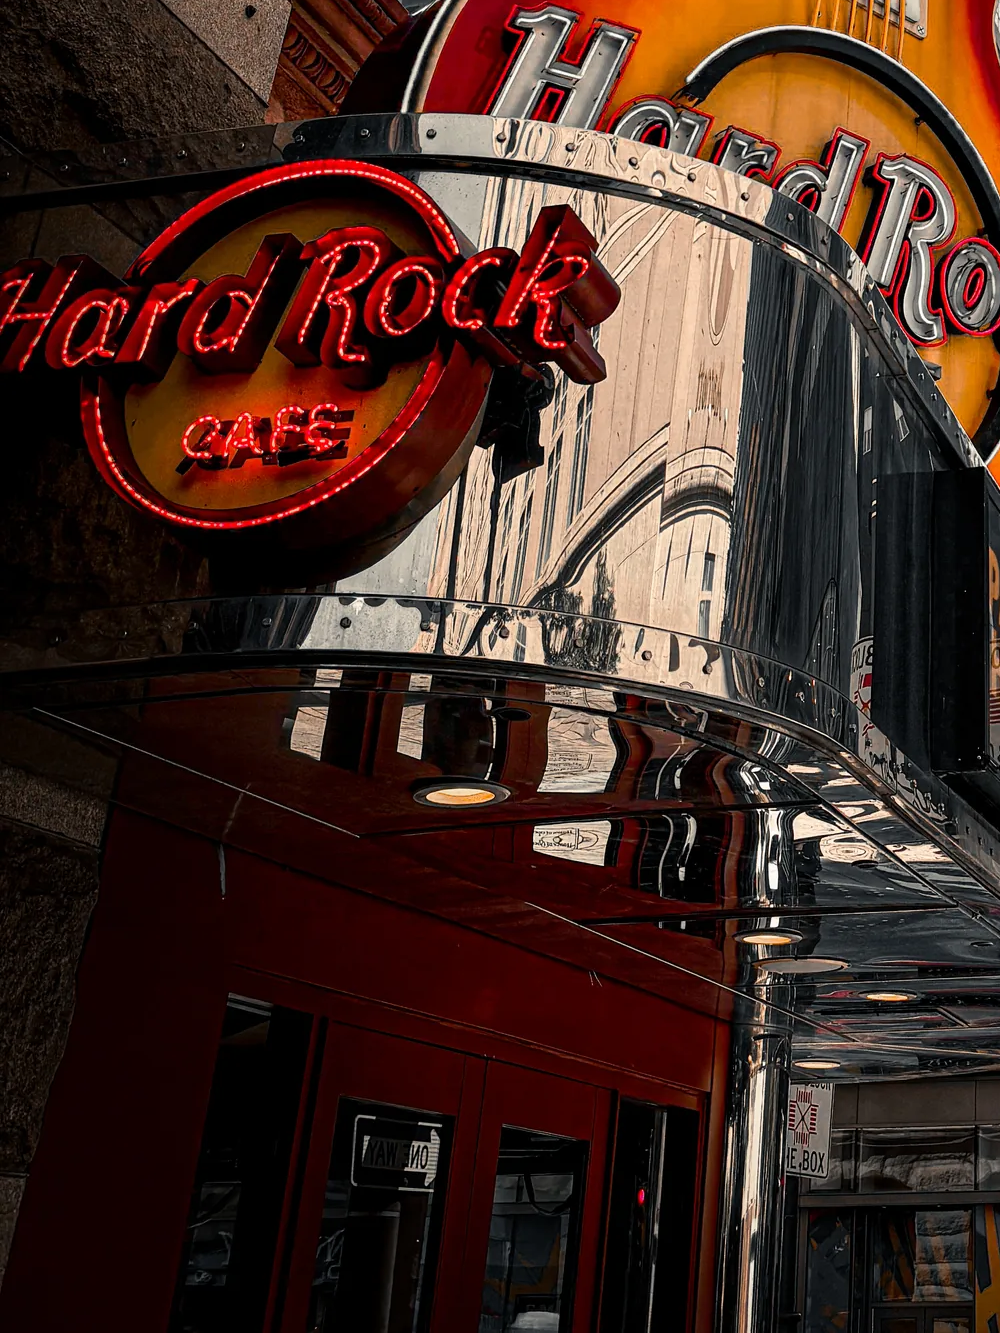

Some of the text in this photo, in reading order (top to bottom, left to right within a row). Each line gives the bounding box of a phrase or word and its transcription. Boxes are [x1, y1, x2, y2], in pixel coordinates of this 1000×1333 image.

[486, 1, 872, 233] Hard
[0, 209, 612, 377] Hard Rock
[181, 402, 342, 463] CAFE
[802, 1149, 825, 1174] BOX
